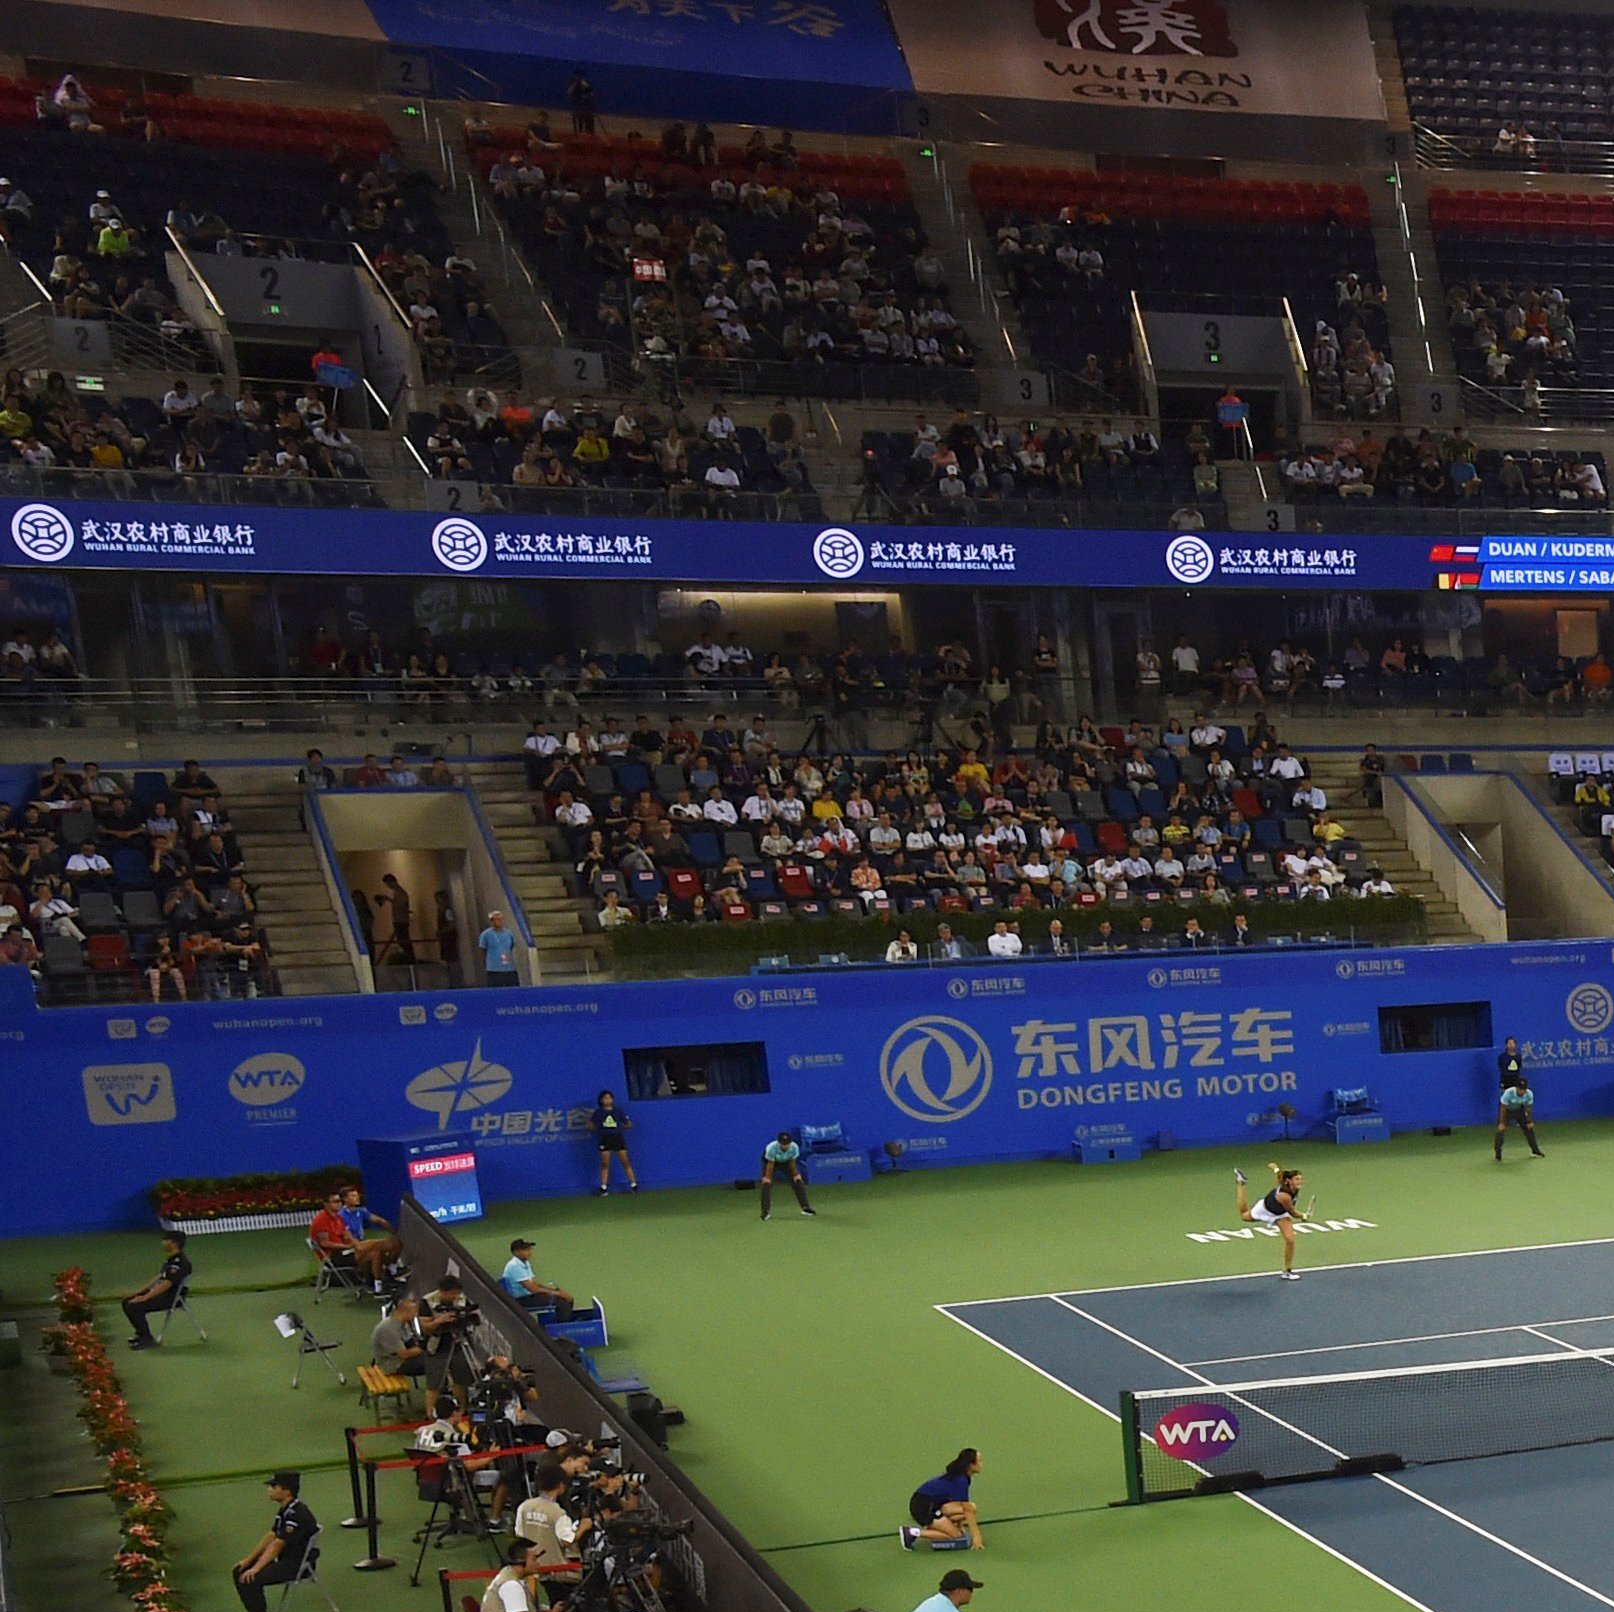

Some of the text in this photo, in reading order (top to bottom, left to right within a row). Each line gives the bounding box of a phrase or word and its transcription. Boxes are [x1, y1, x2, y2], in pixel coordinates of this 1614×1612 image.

[1044, 60, 1252, 88] WUHAN
[1072, 84, 1239, 106] CHINA
[260, 267, 281, 300] 2
[75, 327, 90, 352] 2
[1204, 322, 1220, 350] 3
[574, 358, 588, 381] 2
[1020, 379, 1032, 400] 3
[1267, 510, 1279, 531] 3
[82, 520, 254, 544] 武汉农村商业银行
[495, 533, 652, 554] 武汉农村商业银行
[871, 541, 1016, 561] 武汉农村商业银行
[1489, 542, 1537, 556] DUAN
[1541, 543, 1547, 557] /
[1220, 548, 1357, 566] 武汉农村商业银行
[1491, 570, 1565, 584] MERTENS
[1569, 570, 1575, 584] /
[496, 1001, 599, 1017] wuhanopen.org
[212, 1015, 323, 1032] wuhanopen.org
[1011, 1008, 1295, 1079] 东风汽车
[234, 1070, 300, 1089] WTA
[1017, 1071, 1297, 1110] DONGFENG MOTOR
[414, 1161, 442, 1175] SPEED
[1160, 1419, 1235, 1445] WTA
